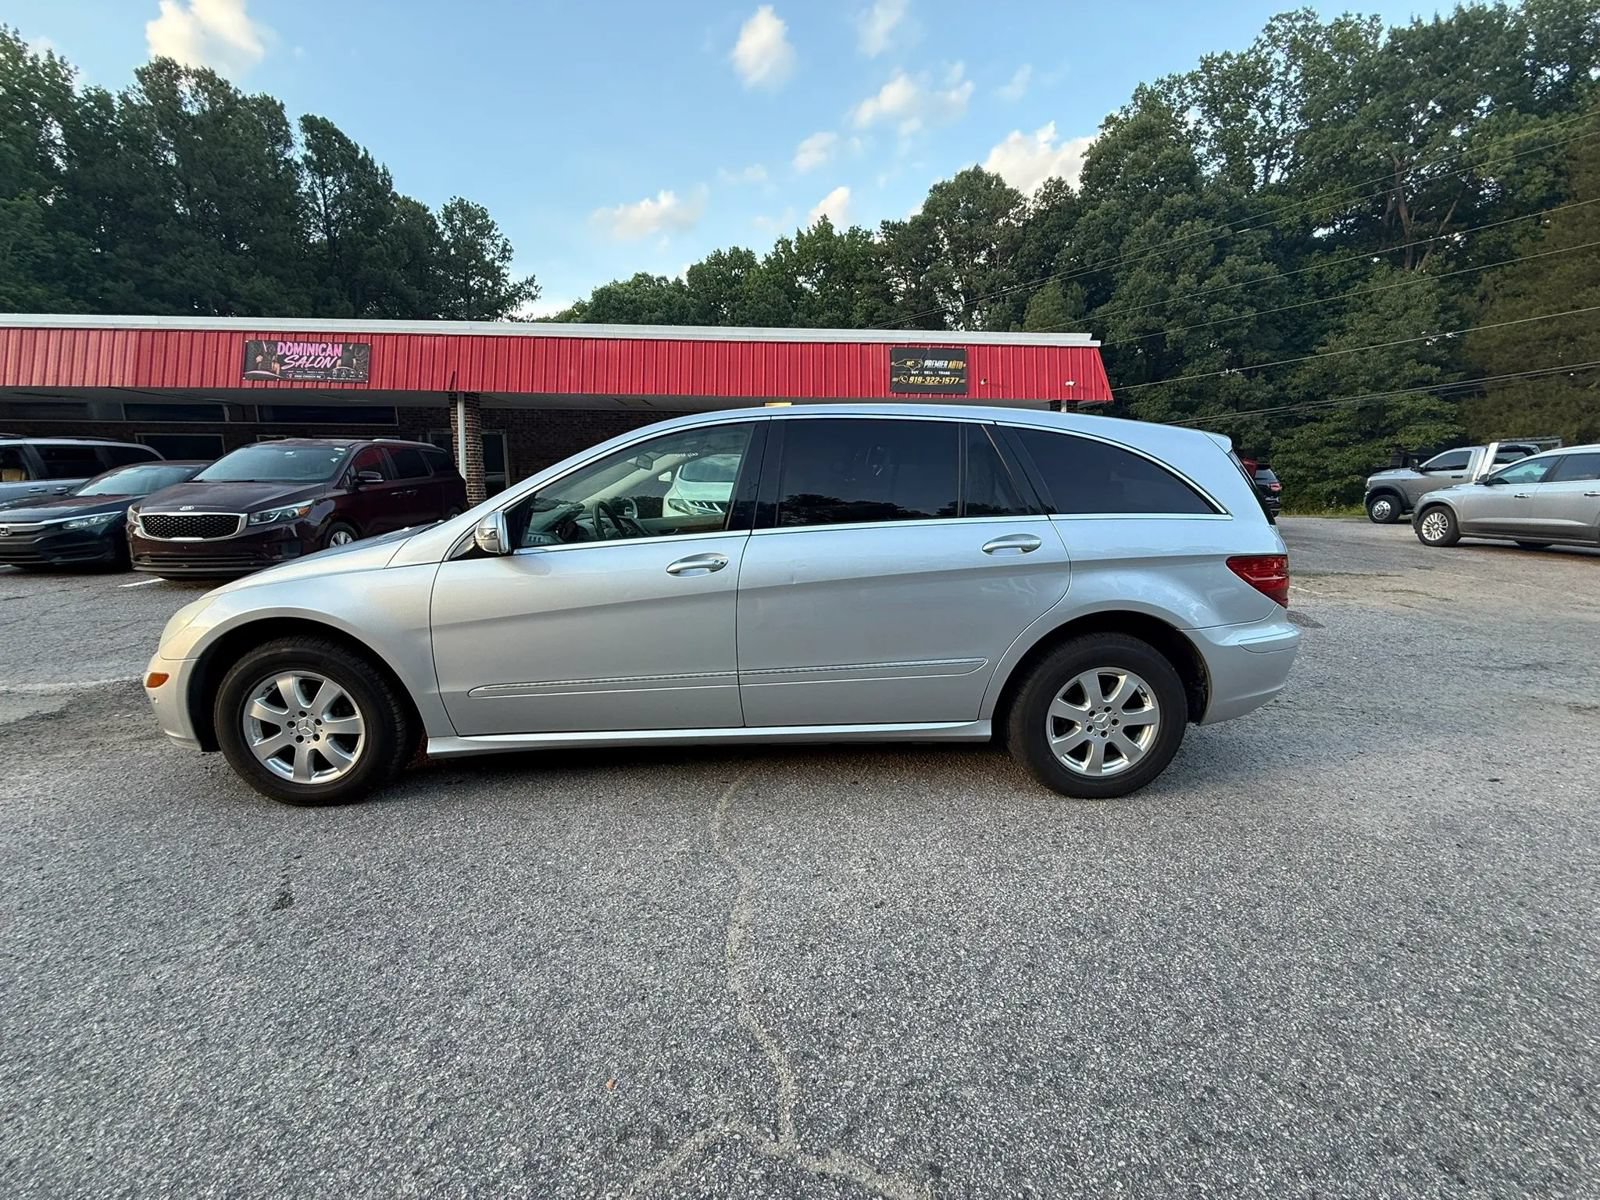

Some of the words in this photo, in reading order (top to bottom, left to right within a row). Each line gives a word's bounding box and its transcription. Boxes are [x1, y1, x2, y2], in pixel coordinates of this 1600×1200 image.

[277, 342, 342, 357] DOMINICAN
[281, 355, 338, 370] SALON
[924, 360, 948, 368] PREMIER
[948, 360, 964, 369] AUTO
[909, 376, 960, 384] 919-322-1577
